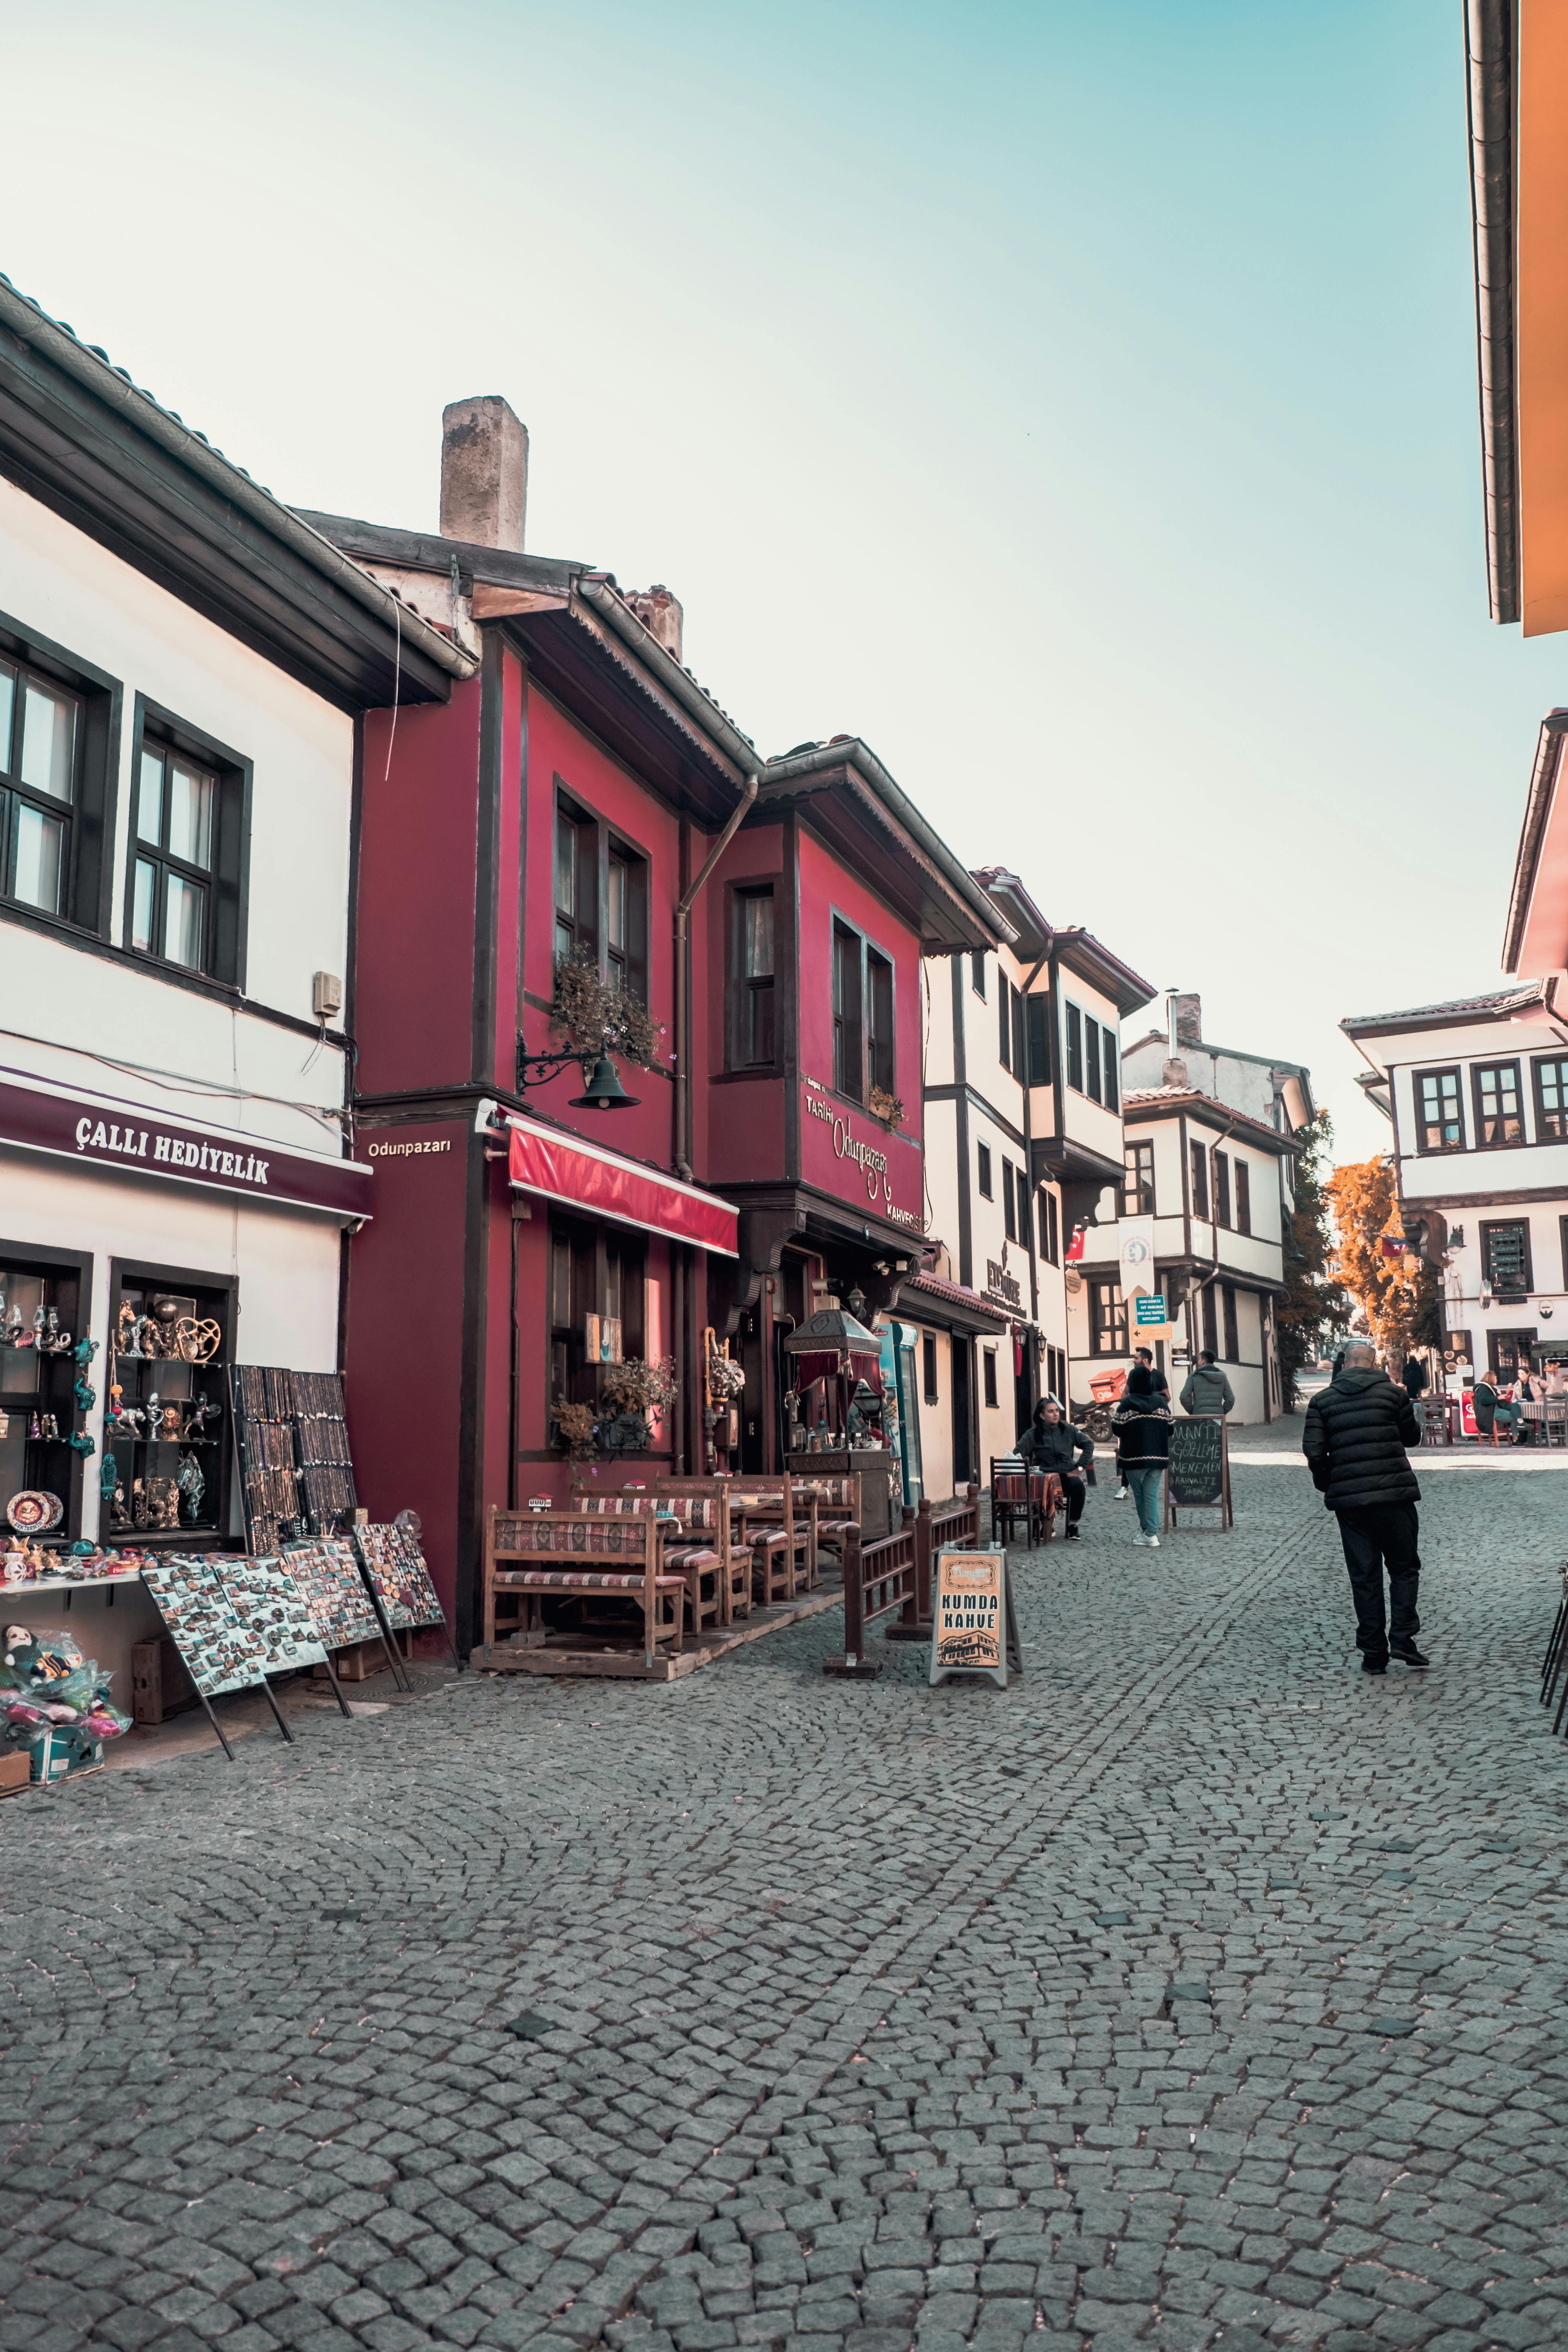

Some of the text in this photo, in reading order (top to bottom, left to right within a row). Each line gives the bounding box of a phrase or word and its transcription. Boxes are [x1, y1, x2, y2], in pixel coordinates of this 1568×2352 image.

[76, 1117, 270, 1184] ÇALLI HEDİYELİK
[369, 1141, 450, 1157] Odunpazarı
[1171, 1423, 1219, 1440] MANTI
[1171, 1459, 1222, 1473] MENEMEN
[1175, 1476, 1216, 1485] KAHVALTI
[942, 1594, 998, 1610] KUMDA
[944, 1613, 995, 1629] KAHVE
